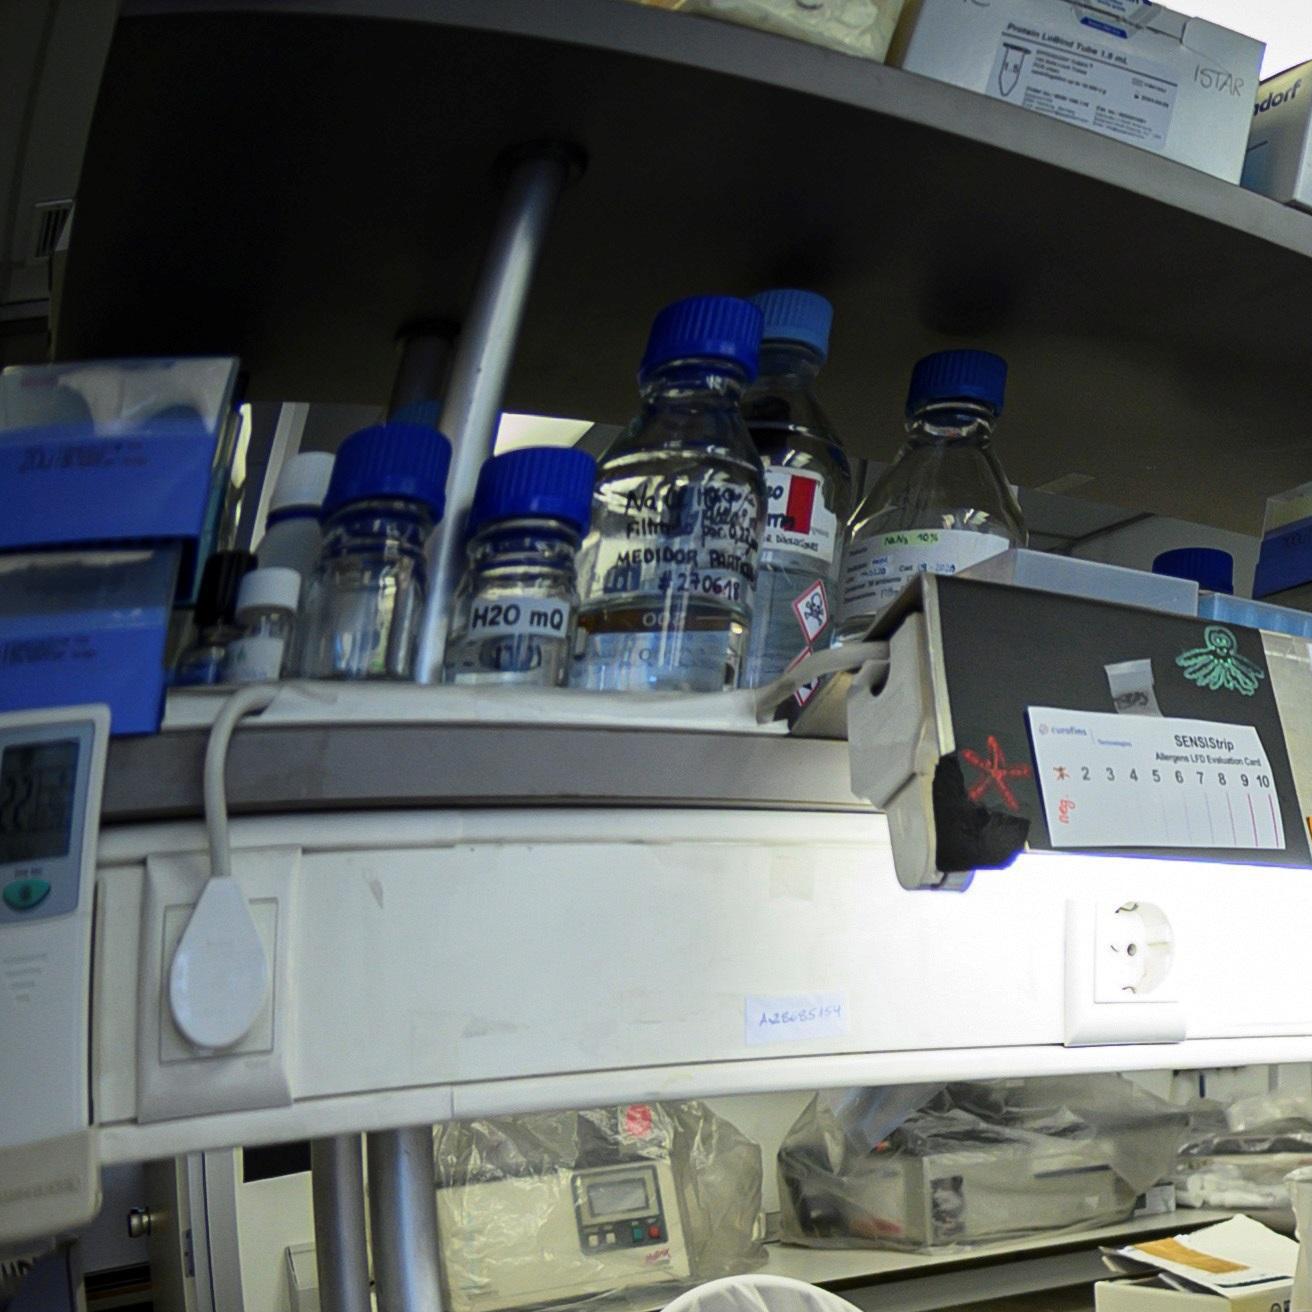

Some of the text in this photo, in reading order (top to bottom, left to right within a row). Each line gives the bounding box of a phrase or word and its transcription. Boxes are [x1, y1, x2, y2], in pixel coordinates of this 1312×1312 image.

[1007, 22, 1040, 40] Protein
[1193, 65, 1245, 97] ISTAR
[616, 549, 698, 569] MEDIDOR
[471, 603, 563, 631] H2O mQ
[1174, 734, 1235, 752] SENSIStrip
[1155, 751, 1190, 764] Allergens
[1207, 755, 1244, 767] Evaluation
[1245, 757, 1262, 767] Card
[1081, 766, 1270, 788] 2 3 4 5 6 7 8 9 10
